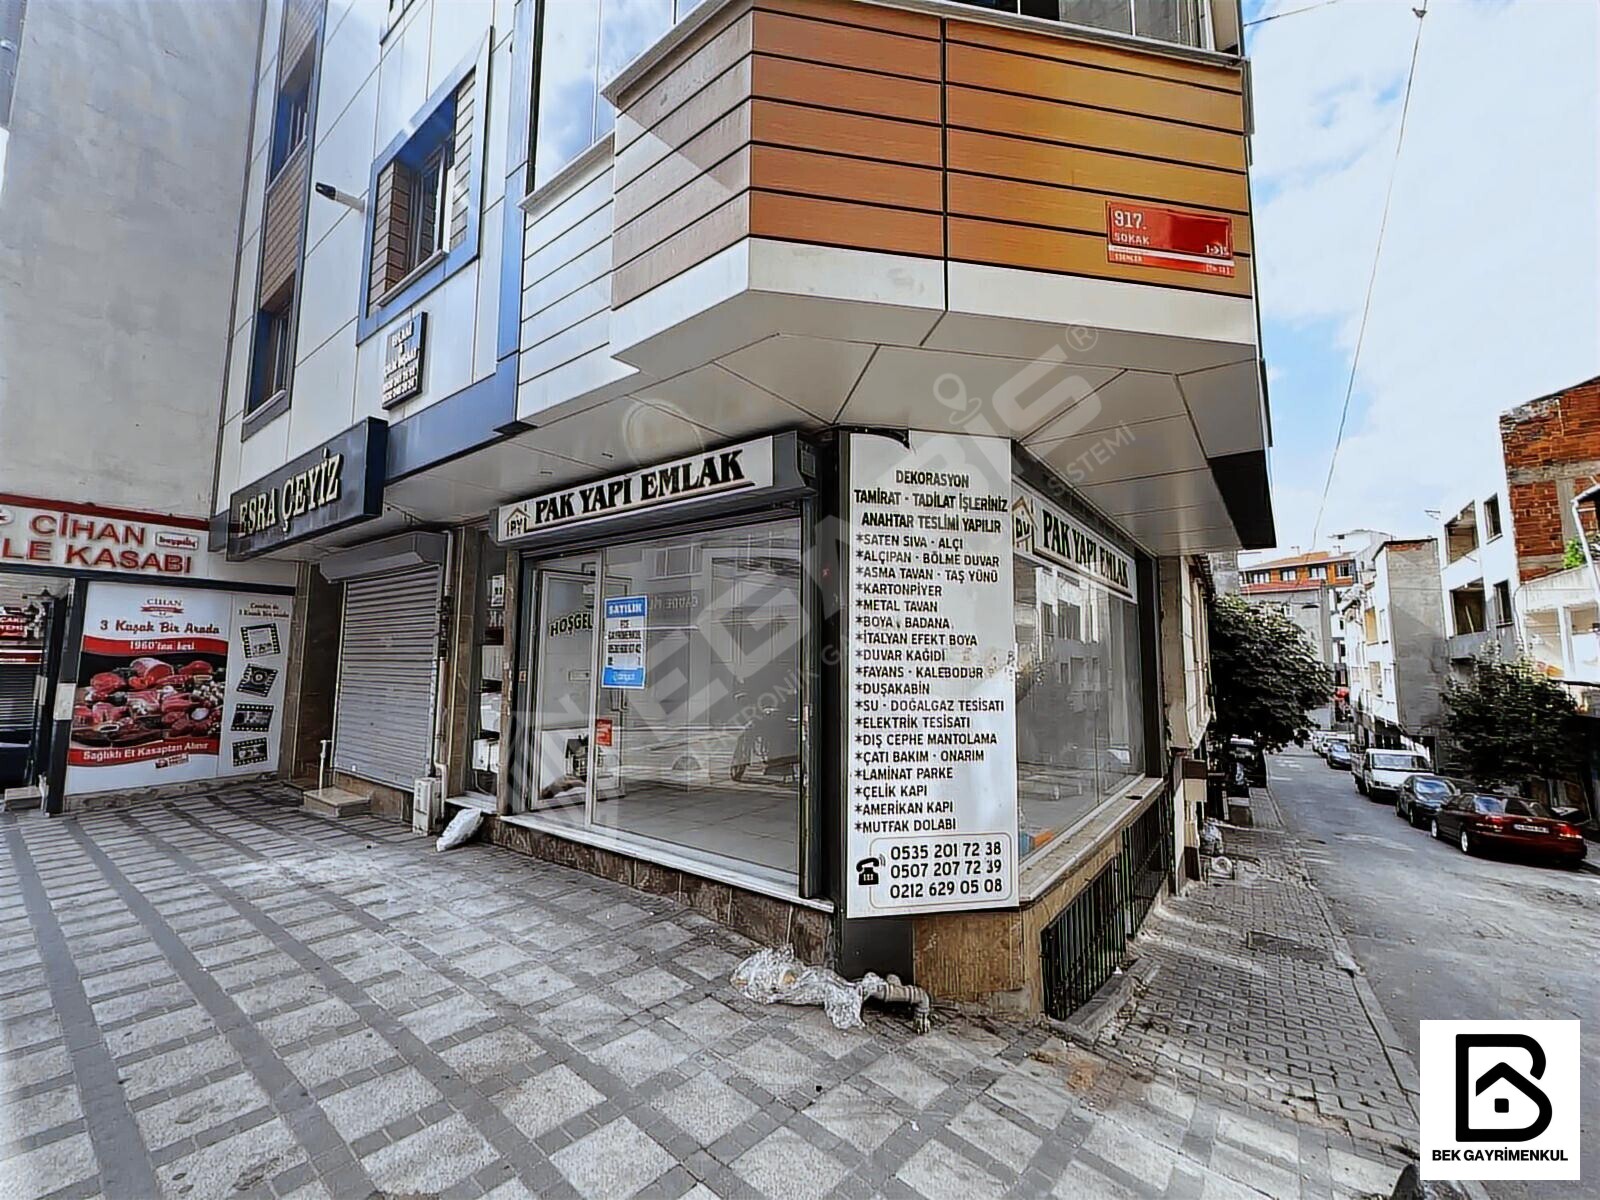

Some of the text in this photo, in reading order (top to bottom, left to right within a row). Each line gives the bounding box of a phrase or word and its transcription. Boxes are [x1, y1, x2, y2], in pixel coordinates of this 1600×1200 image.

[1114, 232, 1150, 245] SOKAK
[896, 470, 969, 488] DEKORASYON
[238, 447, 342, 538] ESRA ÇEYİZ
[535, 492, 575, 524] PAK
[640, 450, 744, 500] EMLAK
[854, 488, 901, 505] TAMİRAT
[913, 491, 956, 508] TADİLAT
[959, 493, 1008, 512] İŞLERİNİZ
[31, 512, 145, 545] CİHAN
[862, 512, 1001, 533] ANAHTAR TESLİMİ YAPILIR
[903, 536, 927, 547] SIVA
[939, 538, 963, 551] ALÇI
[1042, 509, 1071, 560] PAK
[1072, 528, 1097, 573] YAPI
[1099, 546, 1128, 589] EMLAK
[66, 544, 191, 573] KASABI
[923, 551, 960, 564] BÖLME
[964, 555, 1000, 567] DUVAR
[900, 568, 933, 579] TAVAN
[945, 570, 964, 584] TAŞ
[969, 569, 998, 582] YÜNÜ
[608, 603, 642, 614] SATILIK
[904, 601, 938, 612] TAVAN
[100, 620, 108, 630] 3
[116, 620, 154, 634] Kuşak
[184, 623, 219, 634] Arada
[905, 617, 950, 629] BADANA
[911, 634, 945, 645] EFEKT
[949, 635, 977, 645] BOYA
[916, 667, 983, 678] KALEBODUR
[891, 699, 954, 711] DOĞALGAZ
[958, 698, 1004, 711] TESİSATI
[922, 714, 970, 728] TESİSATI
[886, 734, 923, 745] CEPHE
[928, 734, 997, 744] MANTOLAMA
[124, 750, 134, 758] Et
[138, 744, 182, 756] Kasaptan
[893, 751, 928, 762] BAKIM
[941, 750, 984, 761] ONARIM
[917, 767, 953, 778] PARKE
[900, 785, 927, 796] KAPI
[926, 802, 953, 813] KAPI
[914, 818, 956, 830] DOLABI
[891, 842, 1001, 860] 0535 201 72 38
[891, 859, 1001, 878] 0507 207 72 39
[890, 879, 1002, 898] 0212 629 05 08
